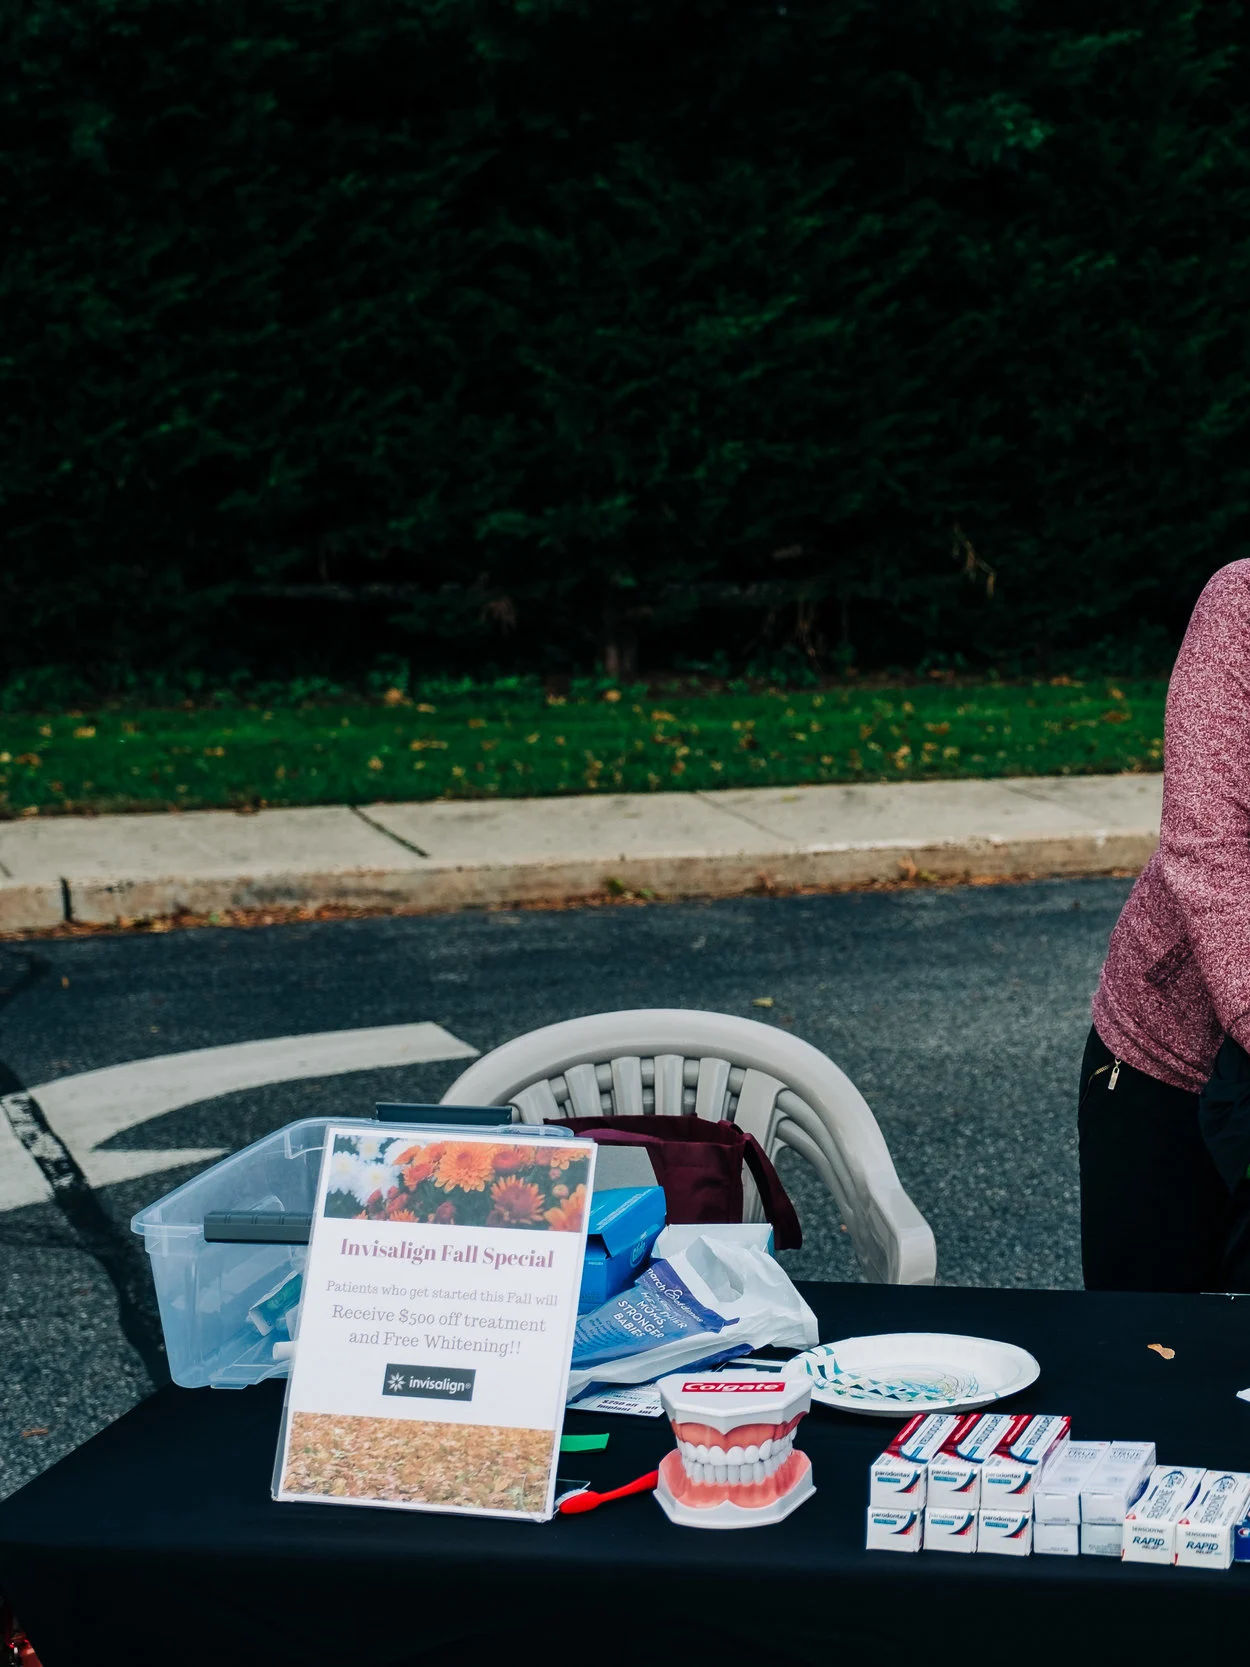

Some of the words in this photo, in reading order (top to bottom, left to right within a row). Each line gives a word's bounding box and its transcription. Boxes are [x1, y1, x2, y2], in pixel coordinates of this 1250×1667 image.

[340, 1238, 436, 1265] Invisalign
[441, 1244, 478, 1263] Fall
[482, 1247, 554, 1270] Special
[326, 1280, 378, 1294] Patients
[381, 1285, 407, 1297] who
[409, 1288, 429, 1300] get
[432, 1288, 477, 1302] started
[480, 1291, 504, 1303] this
[507, 1292, 532, 1306] Fall
[535, 1295, 558, 1307] will
[332, 1304, 395, 1322] Receive
[398, 1308, 435, 1327] $500
[438, 1311, 462, 1327] off
[464, 1314, 547, 1332] treatment
[617, 1300, 665, 1339] STRONGER
[636, 1301, 666, 1329] MOMS,
[612, 1312, 646, 1337] BABIES
[348, 1331, 380, 1345] and
[383, 1332, 419, 1348] Free
[423, 1334, 521, 1357] Whitening!!
[684, 1382, 782, 1393] Colgate
[874, 1470, 911, 1479] parodontax
[931, 1469, 967, 1478] parodontax
[985, 1471, 1021, 1479] parodontax
[871, 1511, 908, 1520] parodontax
[928, 1511, 965, 1520] parodontax
[982, 1514, 1019, 1523] parodontax
[1131, 1526, 1165, 1534] SENSODYNE
[1185, 1531, 1219, 1539] SENSODYNE
[1132, 1536, 1165, 1547] RAPID
[1186, 1541, 1219, 1551] RAPID
